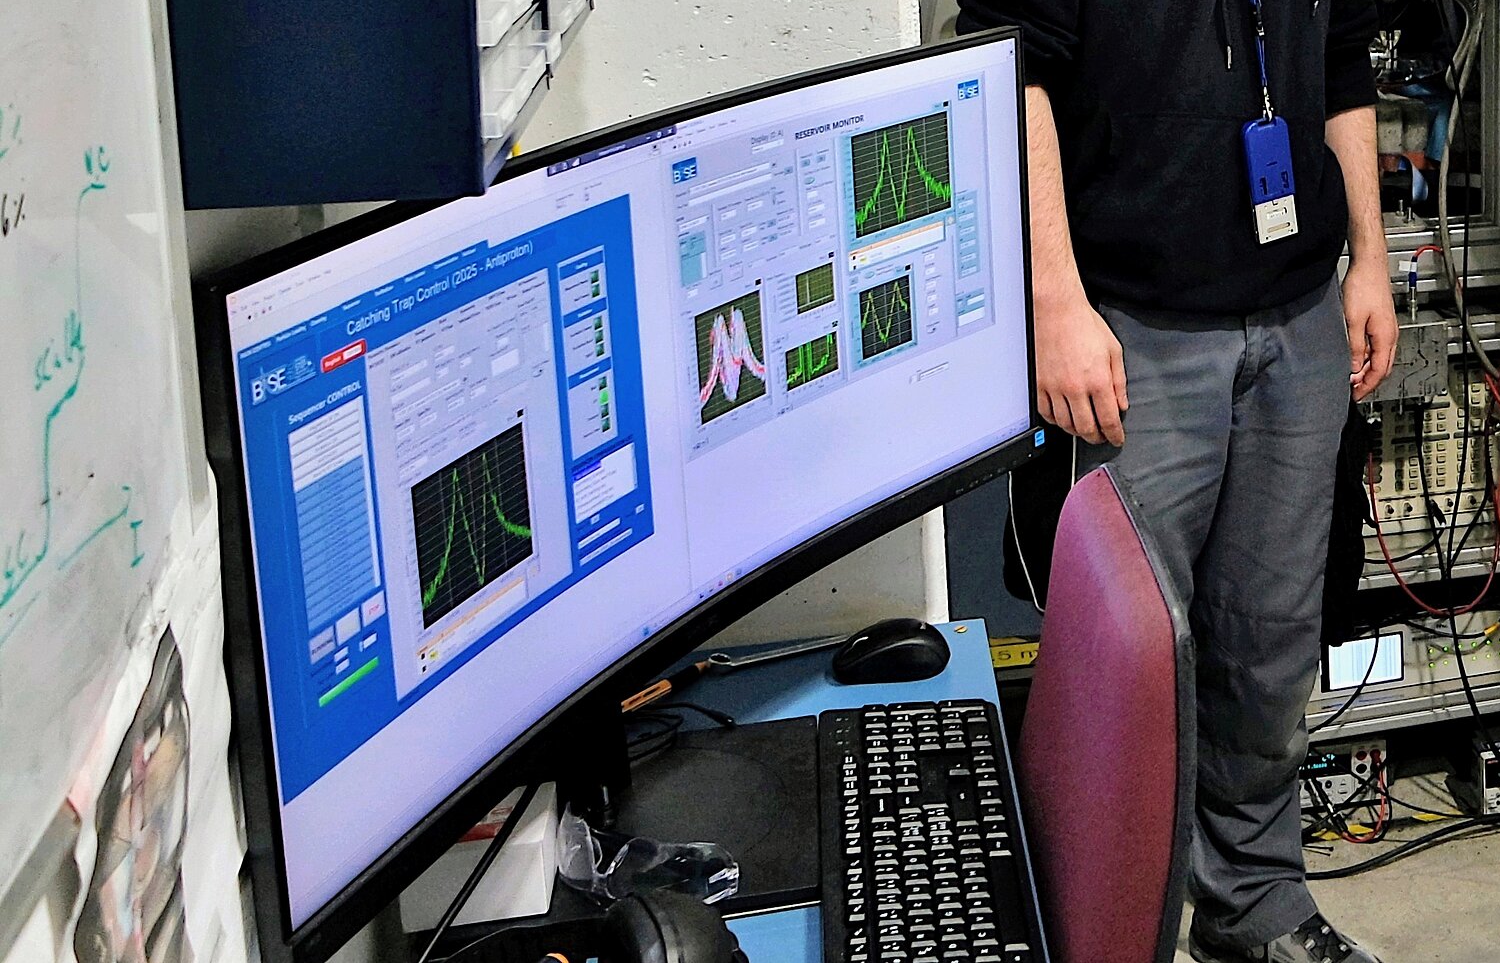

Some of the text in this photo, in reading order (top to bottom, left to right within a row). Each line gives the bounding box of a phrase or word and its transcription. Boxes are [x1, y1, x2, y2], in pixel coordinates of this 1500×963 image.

[795, 114, 865, 141] RESERVOIR MONITOR
[346, 305, 391, 336] Catching
[391, 294, 415, 314] Trap
[416, 276, 450, 302] Control
[452, 263, 478, 288] (2025
[485, 240, 534, 272] Antiproton)
[288, 379, 362, 425] Sequencer CONTROL
